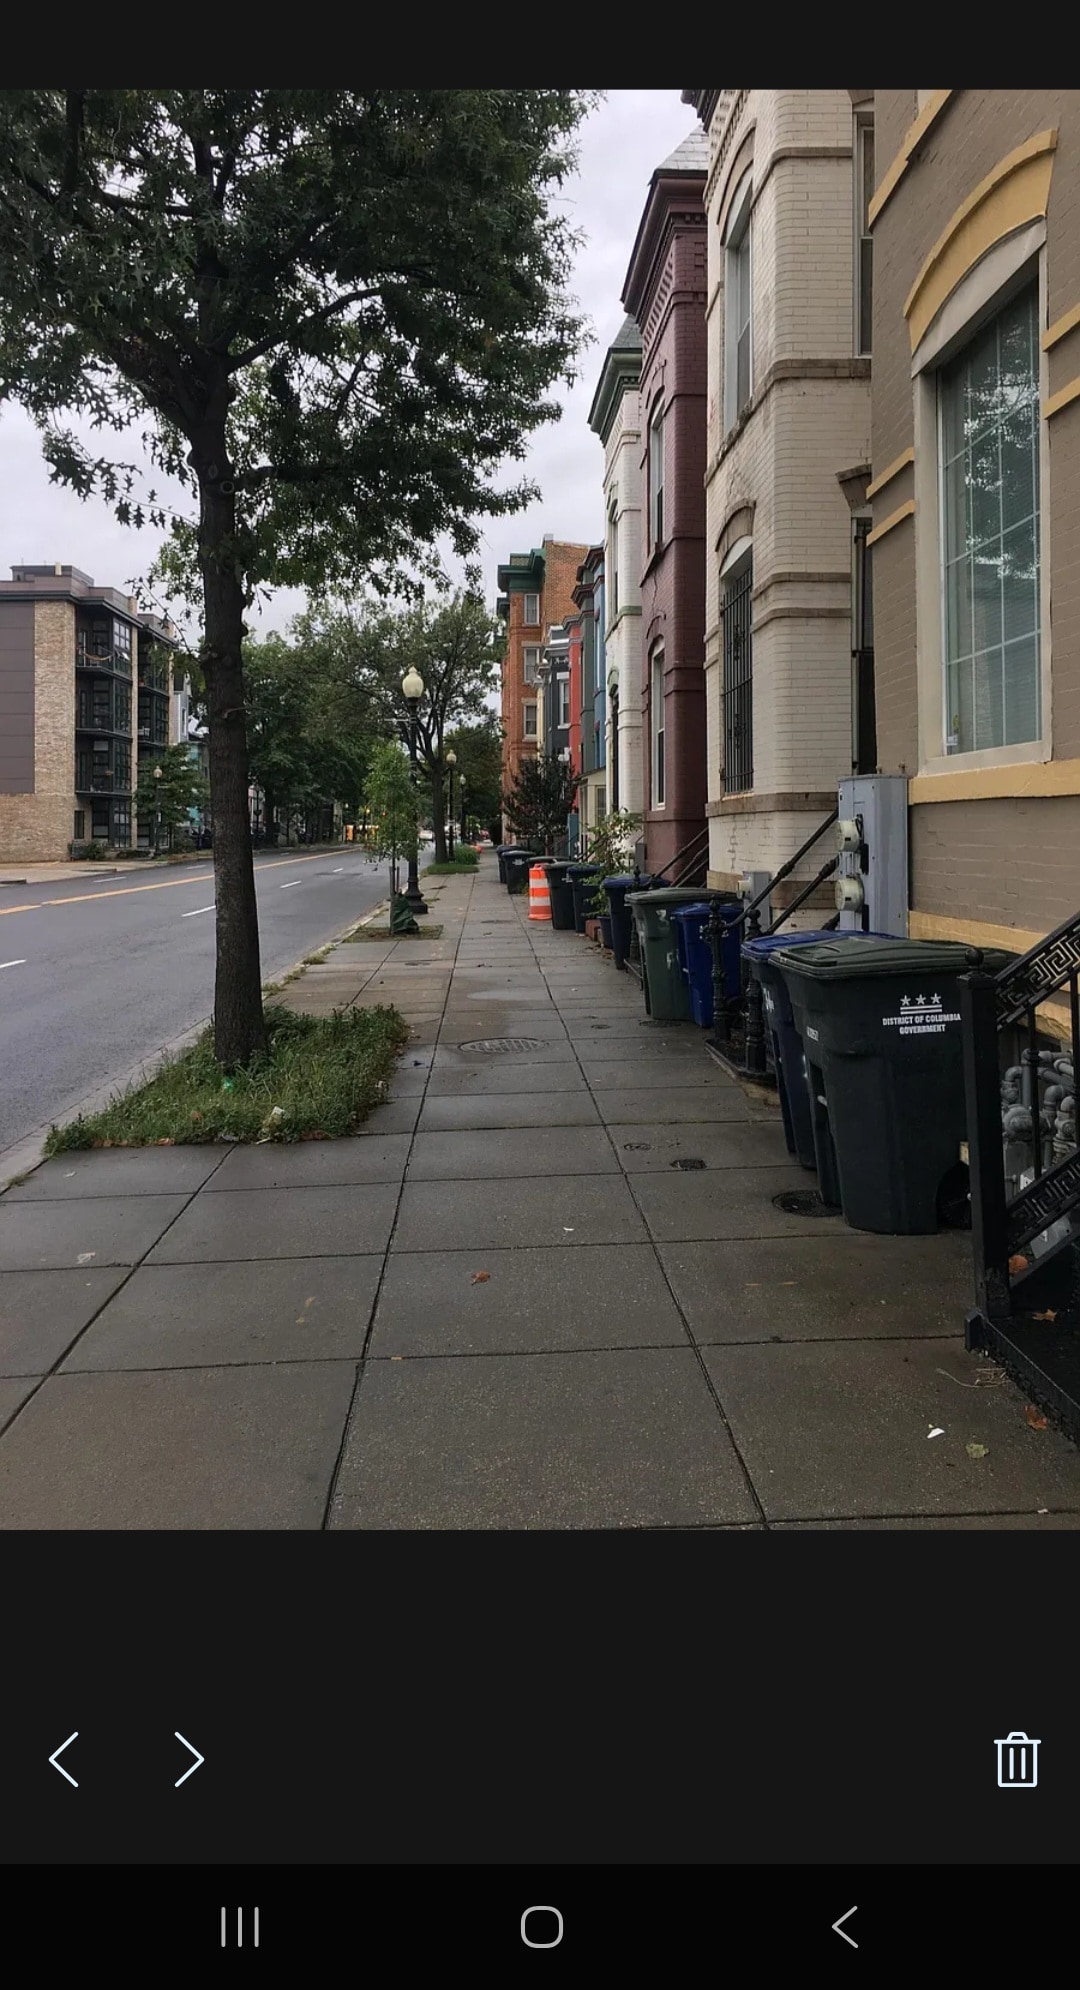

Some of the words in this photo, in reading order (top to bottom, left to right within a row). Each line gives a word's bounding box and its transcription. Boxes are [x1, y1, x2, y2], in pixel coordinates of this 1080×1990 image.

[882, 1016, 913, 1025] DISTRICT
[914, 1015, 924, 1023] OF
[925, 1013, 961, 1022] COLUMBIA
[899, 1024, 946, 1034] GOVERNMENT
